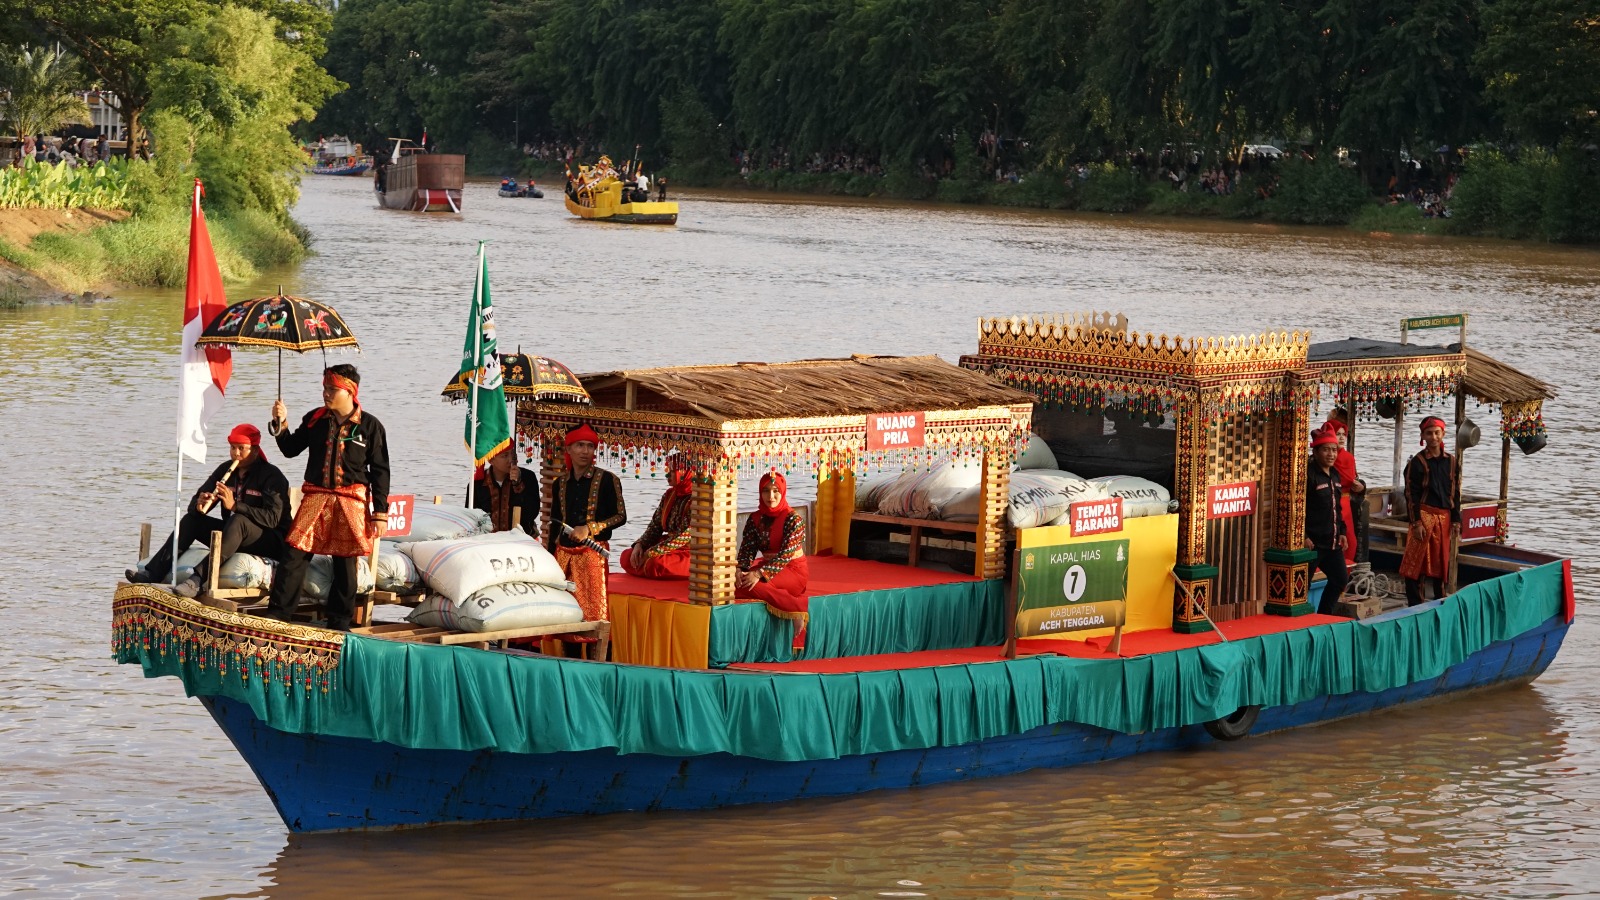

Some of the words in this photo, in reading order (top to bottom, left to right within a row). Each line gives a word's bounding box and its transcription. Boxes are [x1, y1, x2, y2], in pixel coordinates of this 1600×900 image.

[876, 415, 916, 431] RUANG
[883, 430, 909, 446] PRIA
[1008, 486, 1056, 510] KEMIRI
[1214, 486, 1250, 501] KAMAR
[1076, 502, 1118, 519] TEMPAT
[1212, 499, 1251, 515] WANITA
[1074, 515, 1119, 533] BARANG
[1468, 516, 1495, 529] DAPUR
[1050, 551, 1079, 565] KAPAL
[1081, 549, 1101, 562] HIAS
[489, 555, 536, 578] PADI
[1070, 571, 1079, 594] 7
[1050, 605, 1096, 618] KABUPATEN
[1040, 620, 1061, 631] ACEH
[1063, 615, 1105, 628] TENGGARA
